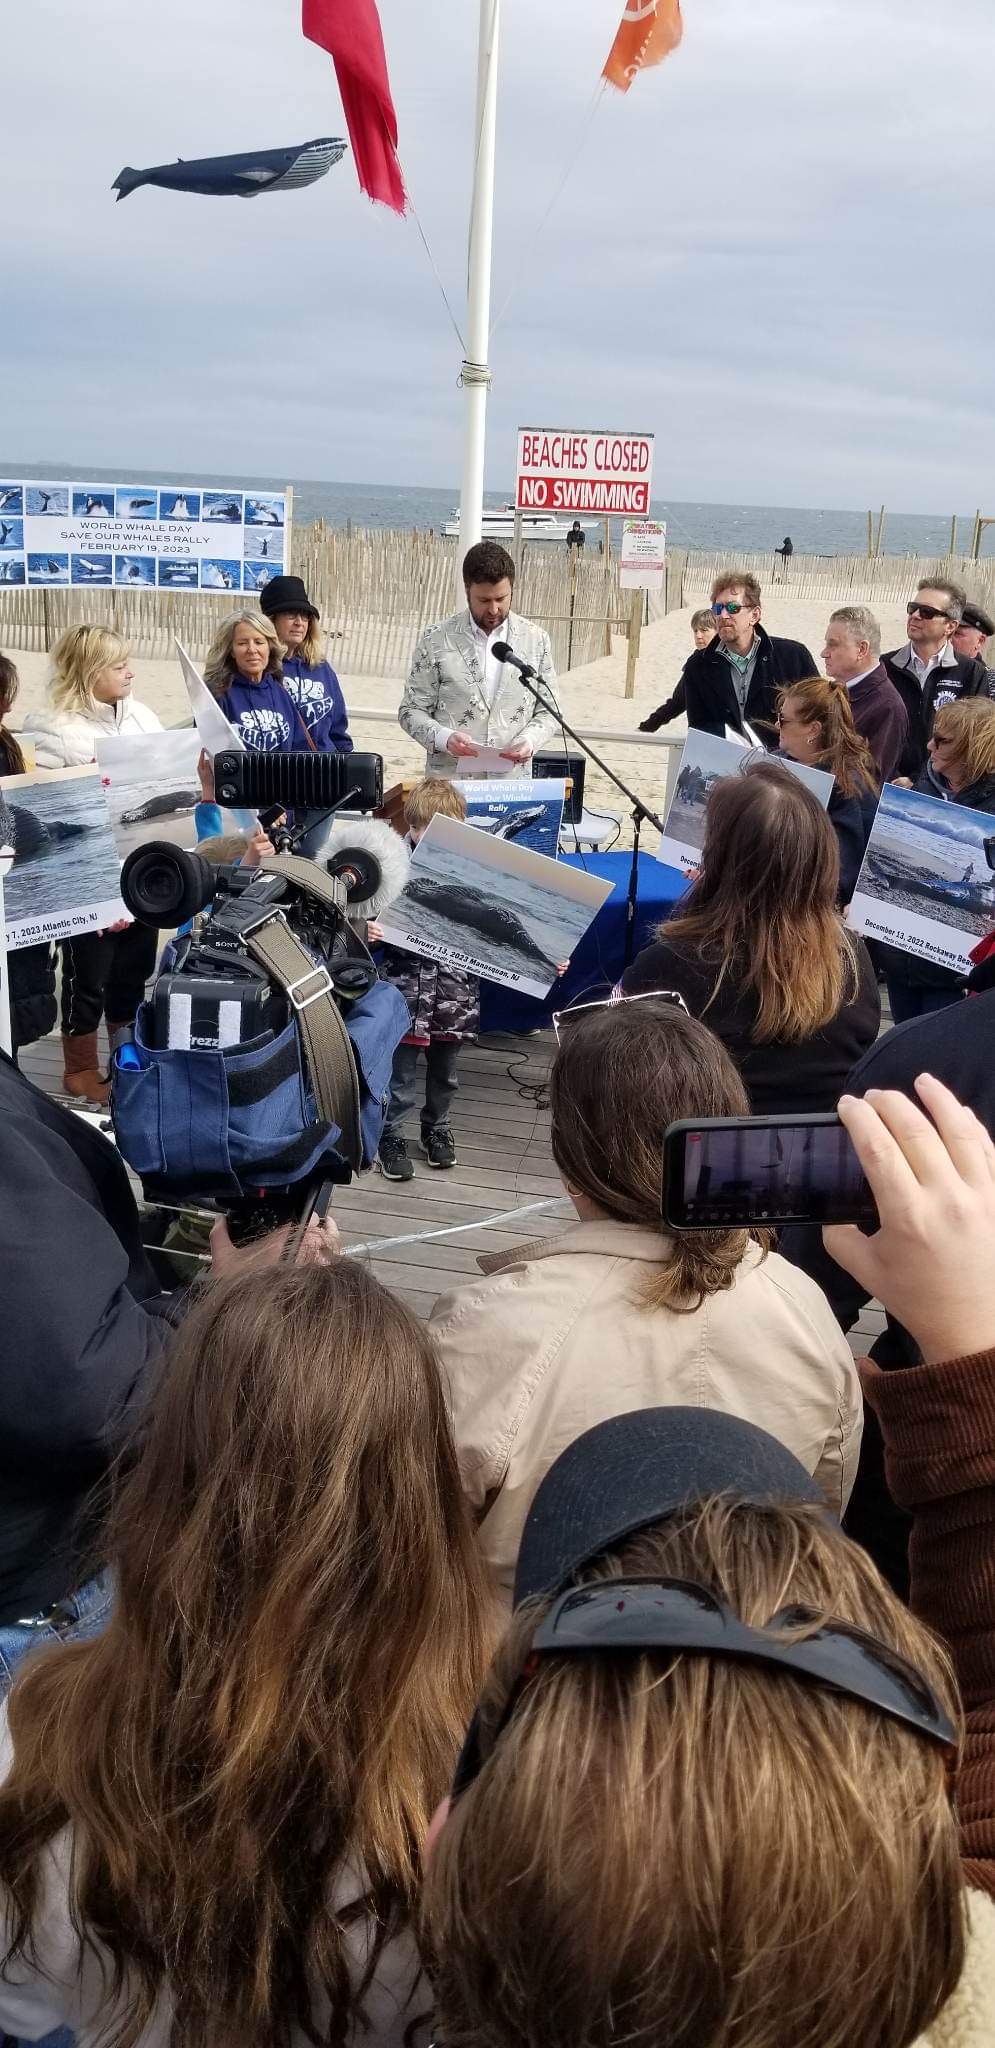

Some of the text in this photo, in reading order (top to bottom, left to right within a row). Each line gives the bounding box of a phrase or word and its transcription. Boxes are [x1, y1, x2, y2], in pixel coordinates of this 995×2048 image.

[522, 435, 649, 472] BEACHES CLOSED
[521, 479, 645, 510] NO SWIMMING
[80, 521, 193, 533] WORLD WHALE DAY
[60, 531, 211, 544] SAVE OUR WHALES RALLY
[80, 542, 191, 554] FEBRUARY 19, 2023
[282, 676, 325, 700] AVE
[240, 709, 284, 729] SAVE
[463, 783, 535, 793] World Whale Day
[488, 804, 509, 813] Rally
[680, 855, 701, 868] Decem
[11, 931, 20, 939] 7,
[21, 925, 41, 937] 2023
[42, 919, 71, 932] Atlantic
[72, 915, 89, 926] City,
[89, 912, 98, 921] NJ
[864, 918, 977, 967] December 13, 2022 Rockaway Beac
[406, 934, 437, 952] February
[437, 946, 448, 956] 13,
[449, 951, 469, 963] 2023
[470, 958, 509, 979] Manasquan,
[510, 973, 520, 982] NJ
[189, 1035, 220, 1047] rezz
